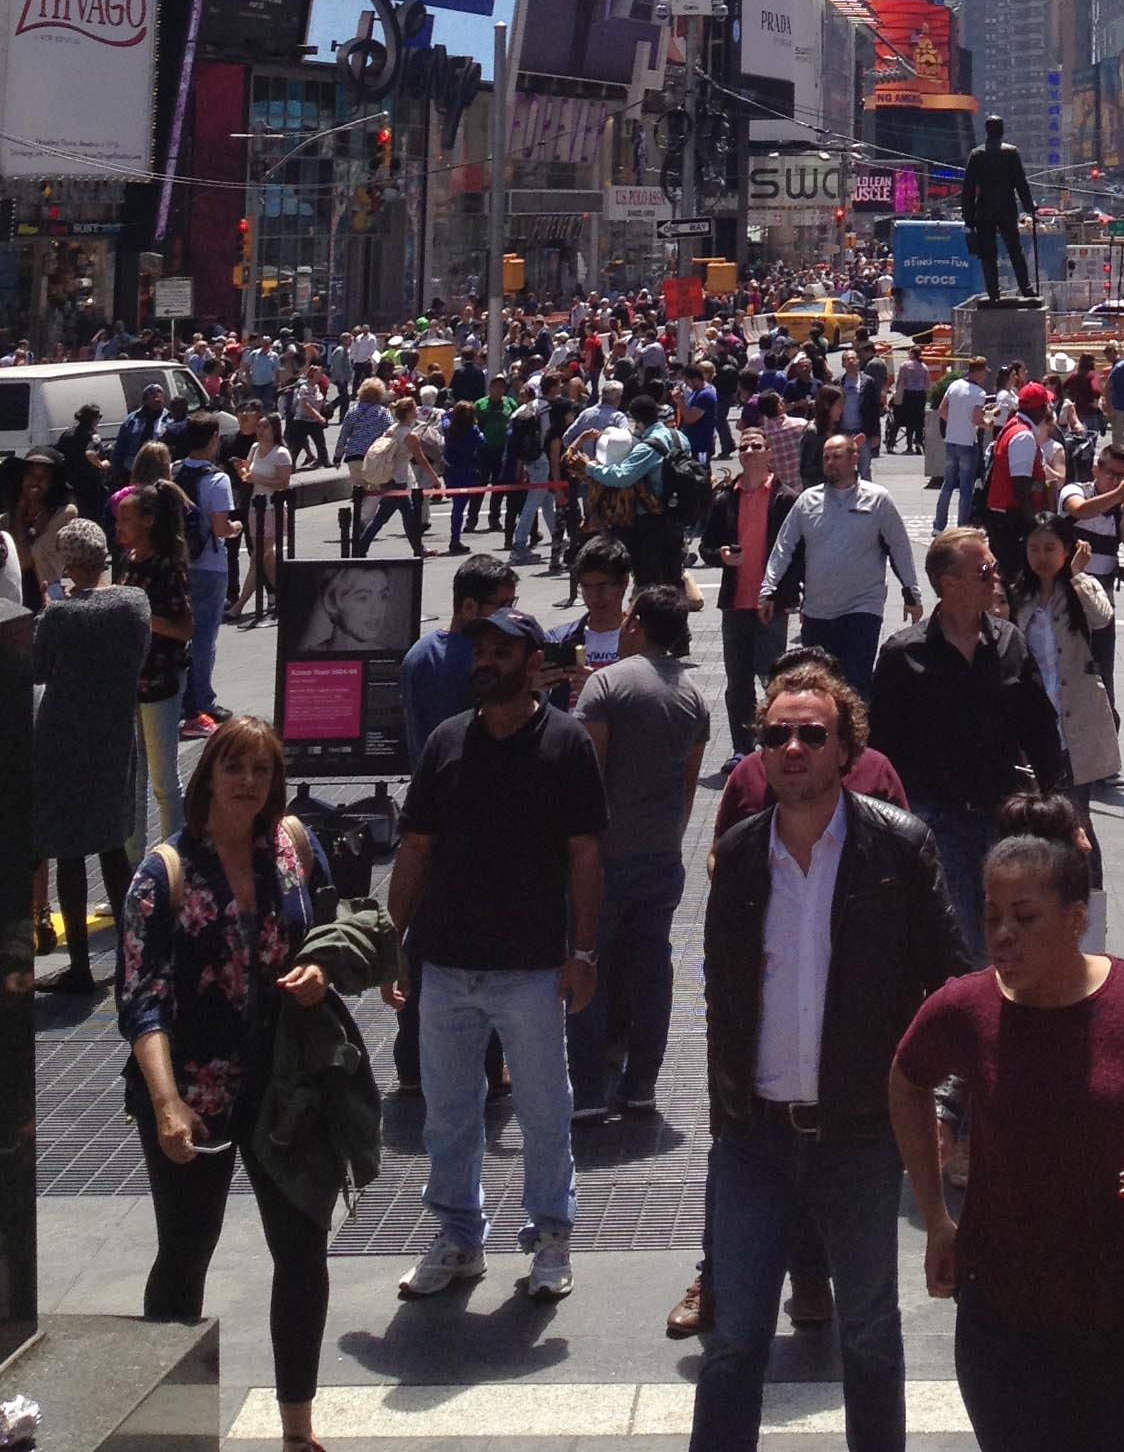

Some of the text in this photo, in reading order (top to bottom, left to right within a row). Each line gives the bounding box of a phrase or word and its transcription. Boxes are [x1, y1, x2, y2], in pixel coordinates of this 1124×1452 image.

[761, 10, 793, 35] PRADA
[870, 176, 892, 187] LEAN
[689, 223, 708, 232] WAY
[915, 274, 957, 285] crocs
